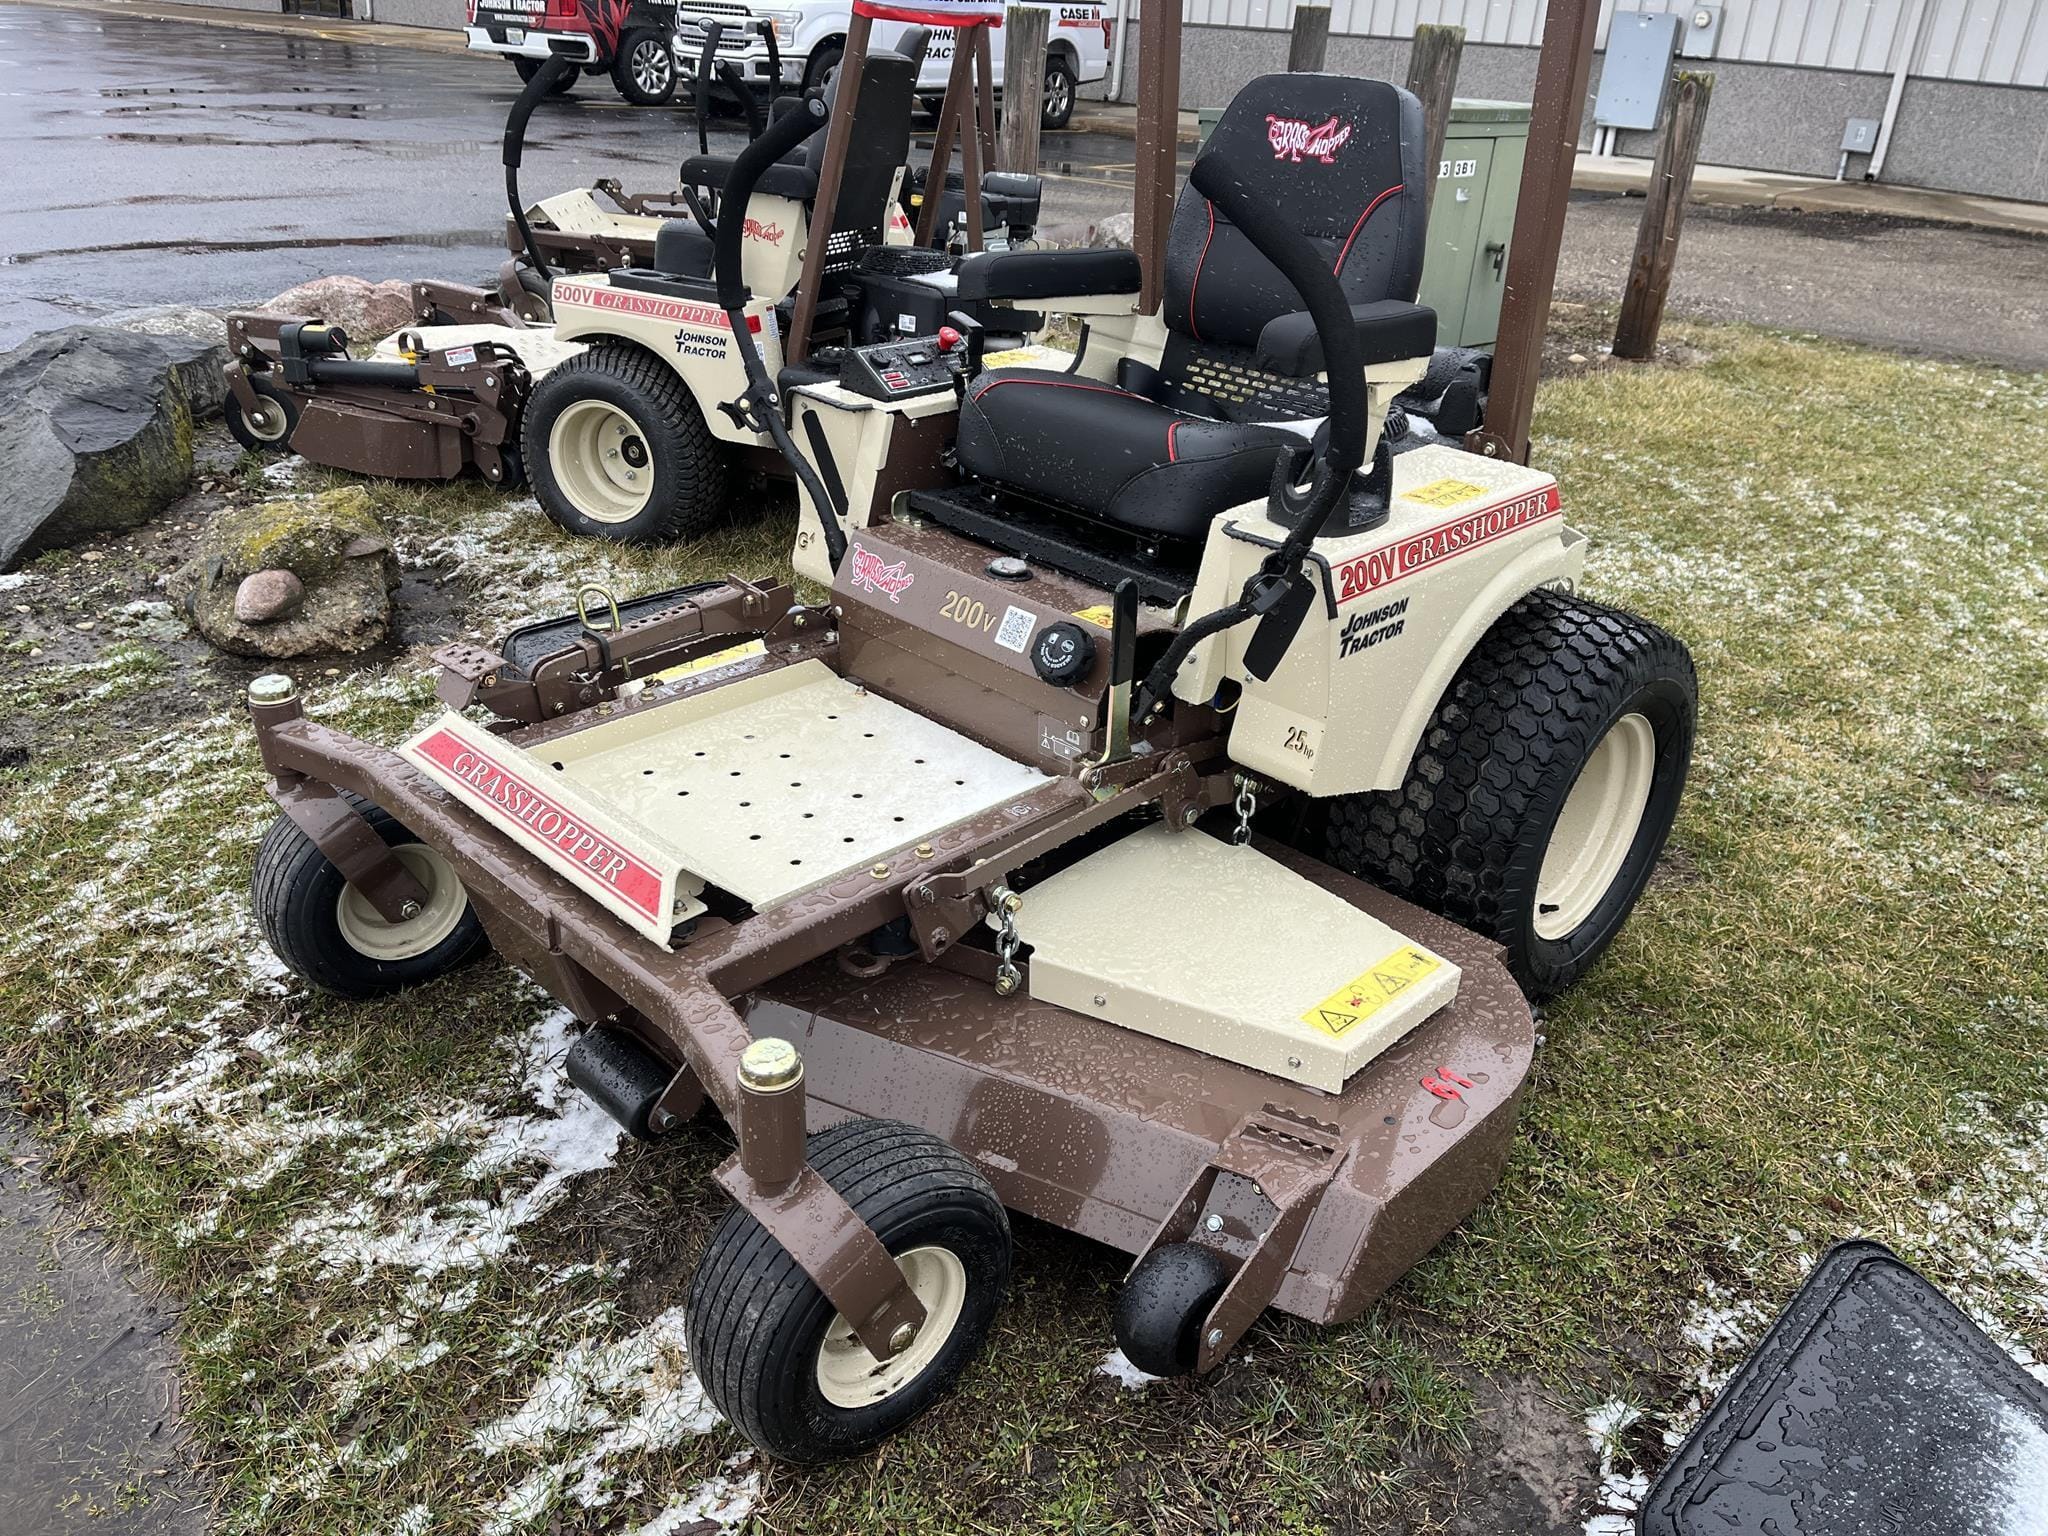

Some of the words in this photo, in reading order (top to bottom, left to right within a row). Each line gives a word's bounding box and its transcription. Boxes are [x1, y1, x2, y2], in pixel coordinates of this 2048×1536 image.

[513, 0, 546, 12] TRACTOR
[1060, 7, 1089, 20] CASE
[553, 285, 593, 304] 500V
[600, 292, 722, 325] GRASSHOPPER
[674, 328, 727, 347] JOHNSON
[676, 341, 727, 360] TRACTOR
[1340, 546, 1396, 598] 200V
[1404, 492, 1549, 567] GRASSHOPPER
[1340, 596, 1410, 638] JOHNSON
[1339, 619, 1405, 660] TRACTOR
[452, 752, 628, 884] GRASSHOPPER
